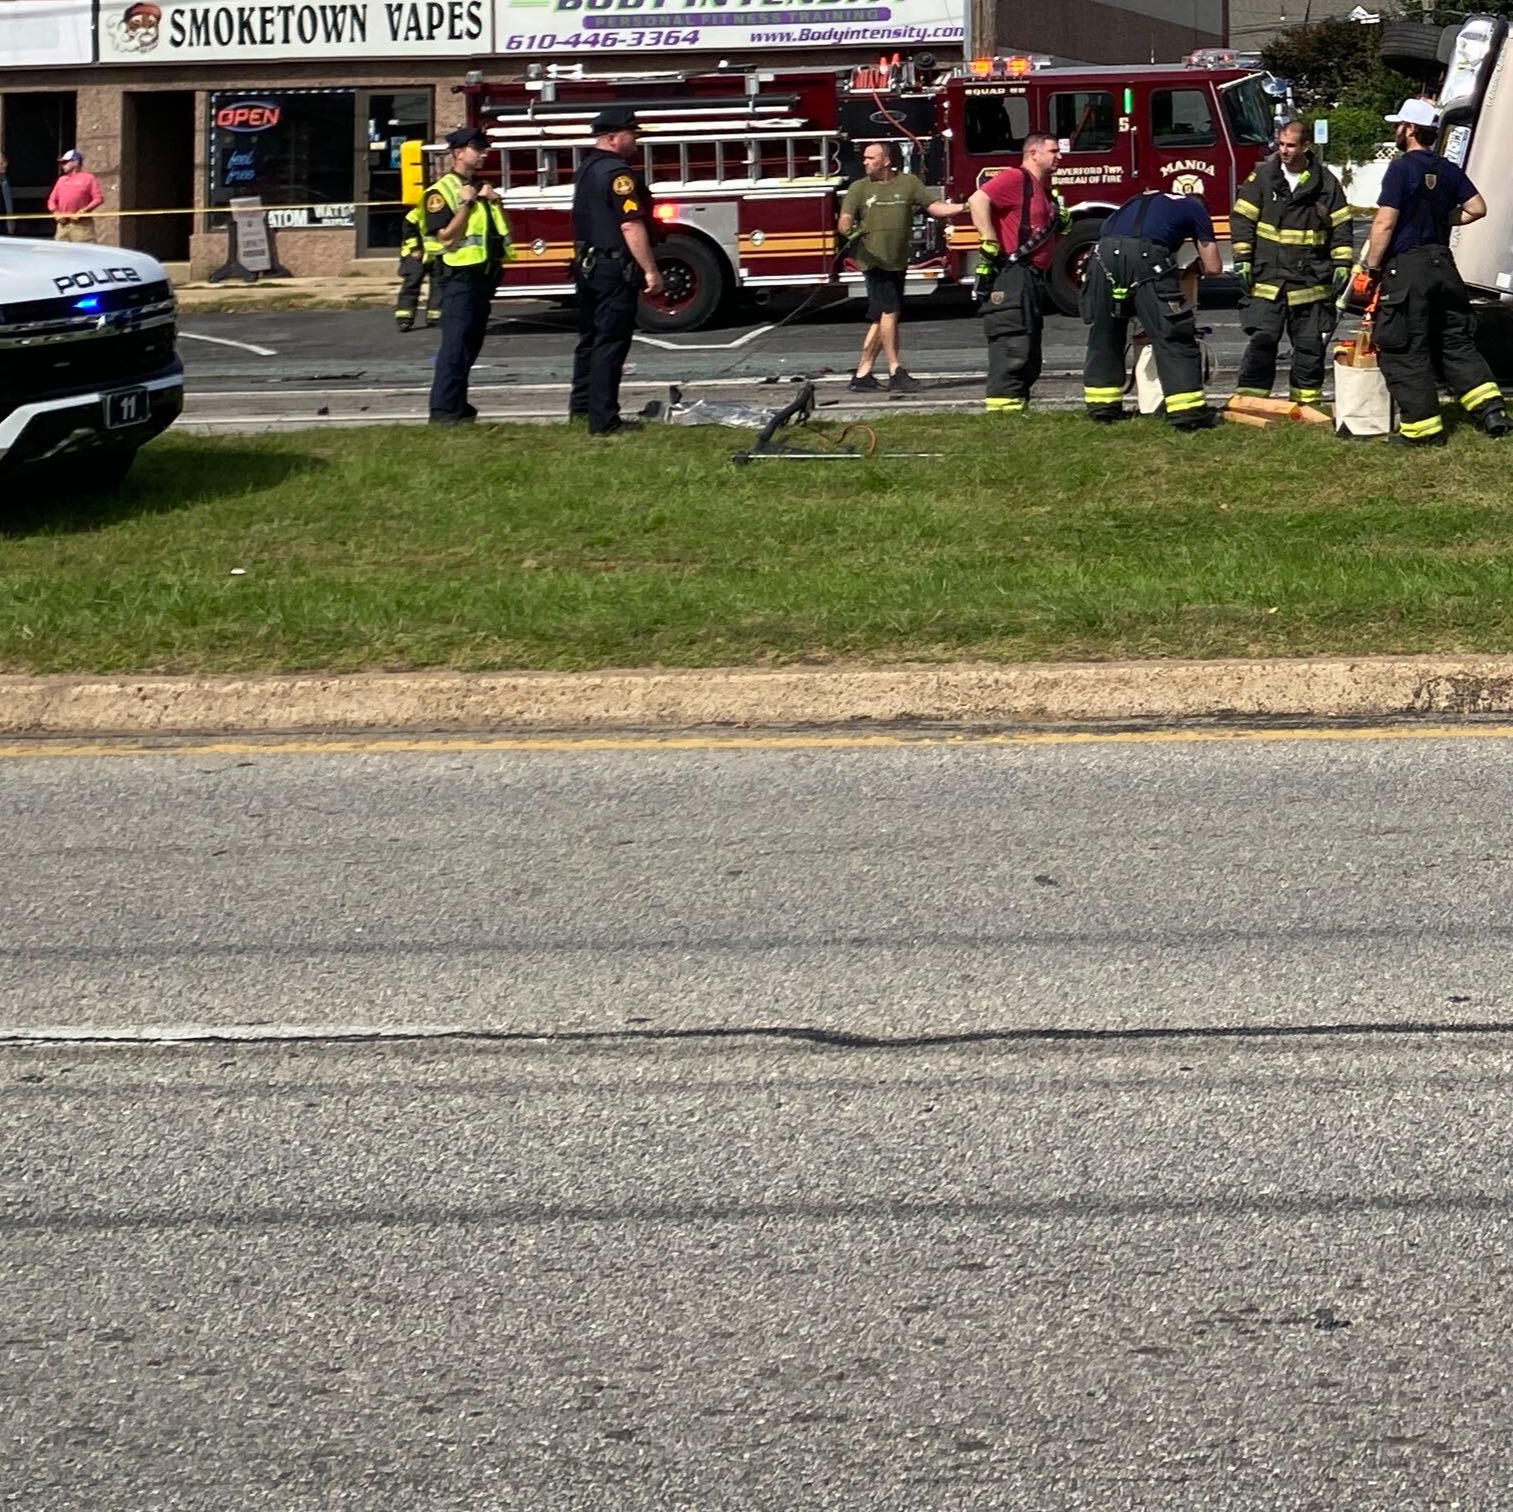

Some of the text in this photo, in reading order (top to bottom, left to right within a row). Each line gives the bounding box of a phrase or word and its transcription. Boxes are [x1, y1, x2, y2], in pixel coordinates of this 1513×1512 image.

[169, 0, 483, 48] SMOKETOWN VAPES
[595, 7, 879, 29] PERSONAL FITNESS TRAINING
[506, 30, 701, 50] 610-446-3364
[217, 106, 281, 126] OPEN
[1055, 166, 1103, 176] AVERFORD
[1159, 159, 1216, 178] MANOA
[1051, 174, 1122, 185] BUREAU OF FIRE
[53, 267, 142, 295] POLICE
[120, 394, 137, 420] 11
